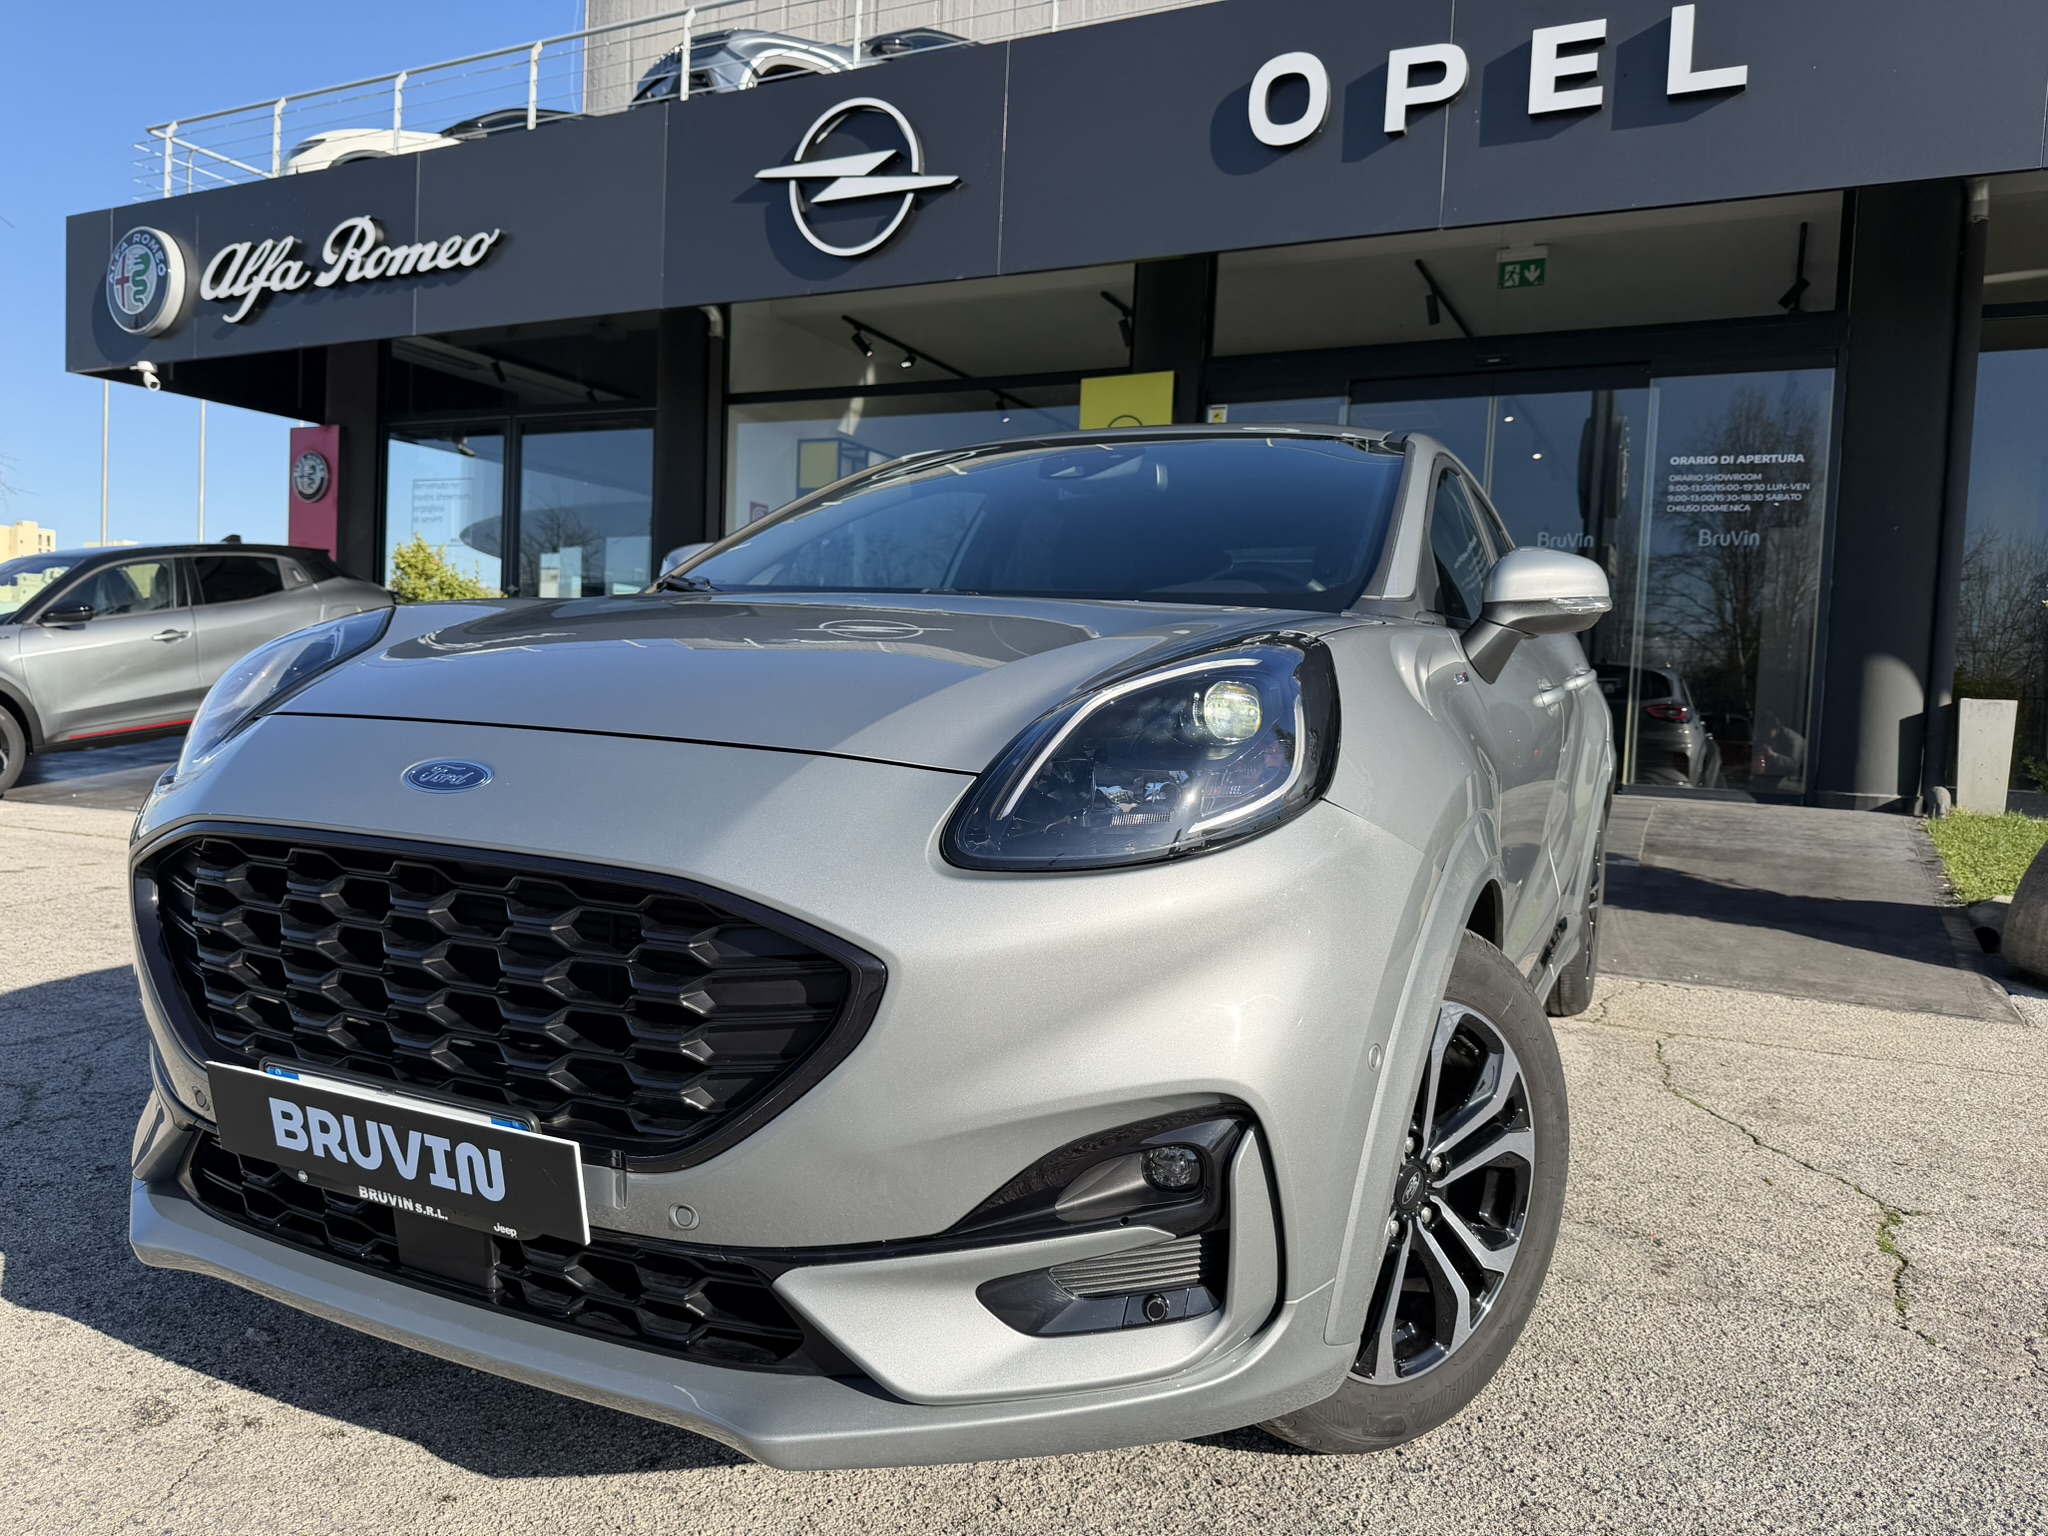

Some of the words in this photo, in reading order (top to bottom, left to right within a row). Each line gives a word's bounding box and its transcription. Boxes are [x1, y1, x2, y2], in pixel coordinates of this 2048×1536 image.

[1248, 4, 1748, 147] OPEL
[132, 233, 167, 277] ROMEO
[200, 235, 311, 324] Alfa
[313, 214, 501, 288] Romeo
[1669, 455, 1718, 466] ORARIO
[1720, 455, 1735, 465] DI
[1736, 453, 1806, 465] APERTURA
[1668, 474, 1704, 483] ORARIO
[1704, 473, 1763, 482] SHOWROOM
[1767, 482, 1811, 492] LUN-VEN
[1765, 492, 1803, 502] SABATO
[1666, 504, 1700, 513] CHIUSO
[1701, 503, 1752, 513] DOMENICA
[1537, 531, 1595, 548] BruVin
[1698, 529, 1761, 547] BruVin
[419, 764, 475, 785] Ford
[268, 1097, 506, 1202] BRUVIN
[358, 1185, 414, 1212] BRUVIN
[415, 1203, 449, 1221] S.R.L.
[493, 1222, 518, 1239] Jeep
